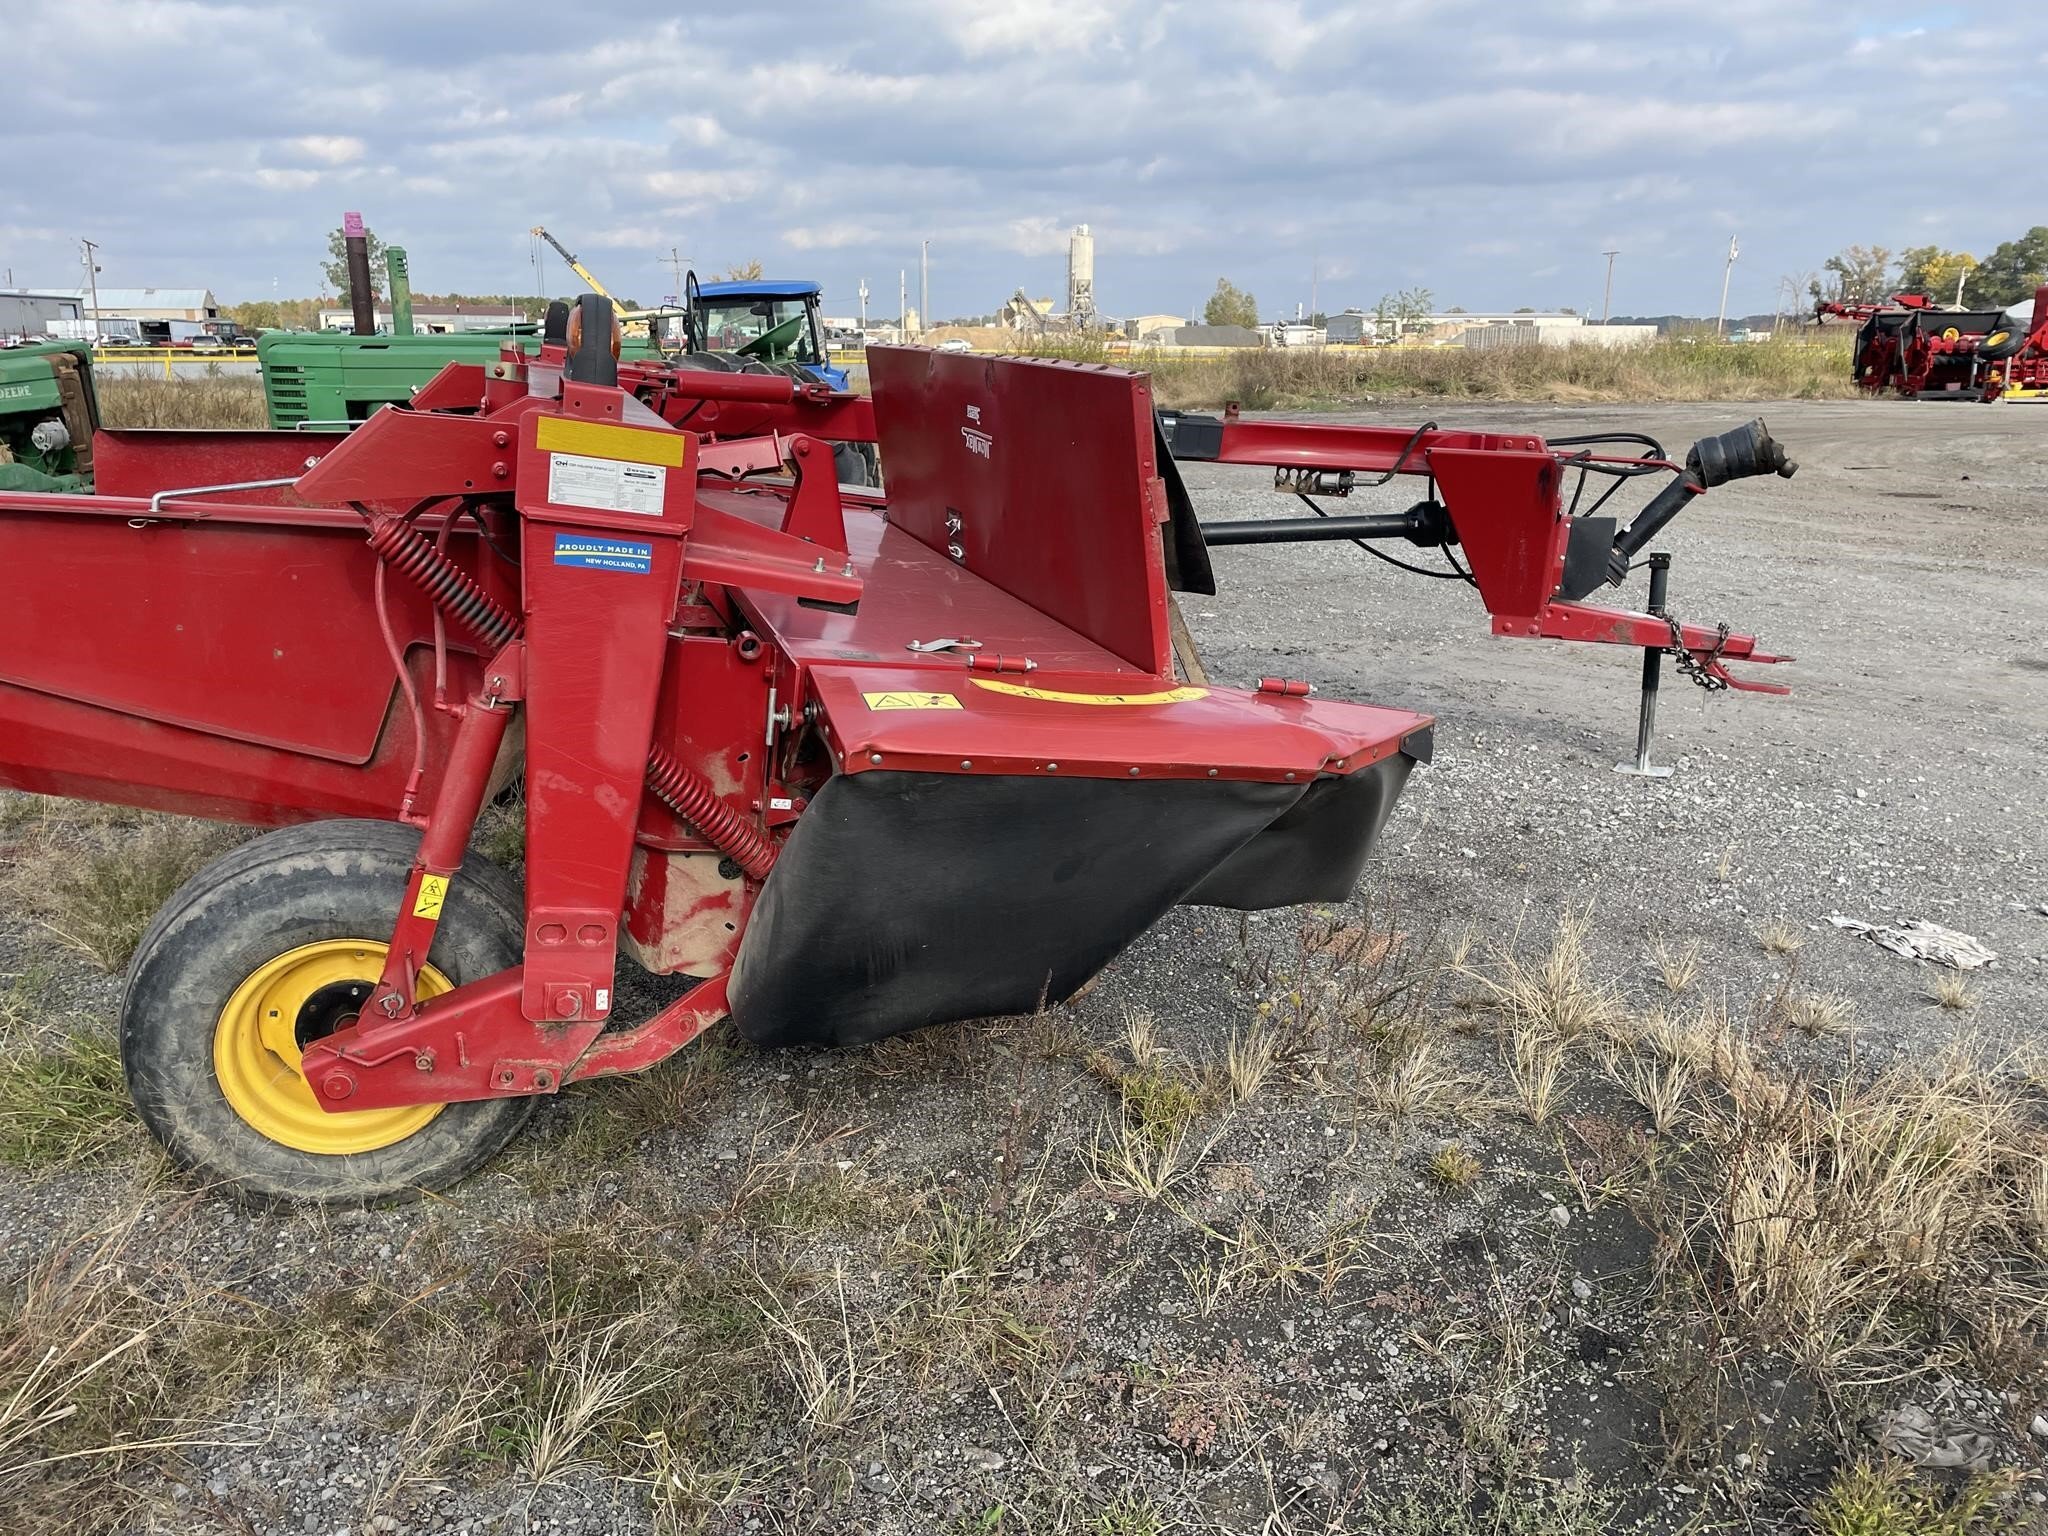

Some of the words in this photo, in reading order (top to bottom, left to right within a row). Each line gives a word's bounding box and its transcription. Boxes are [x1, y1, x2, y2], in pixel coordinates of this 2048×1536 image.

[0, 385, 32, 399] DEERE
[559, 544, 604, 552] PROUDLY
[607, 546, 634, 554] MADE
[585, 557, 602, 565] NEW
[603, 559, 637, 569] HOLLAND,
